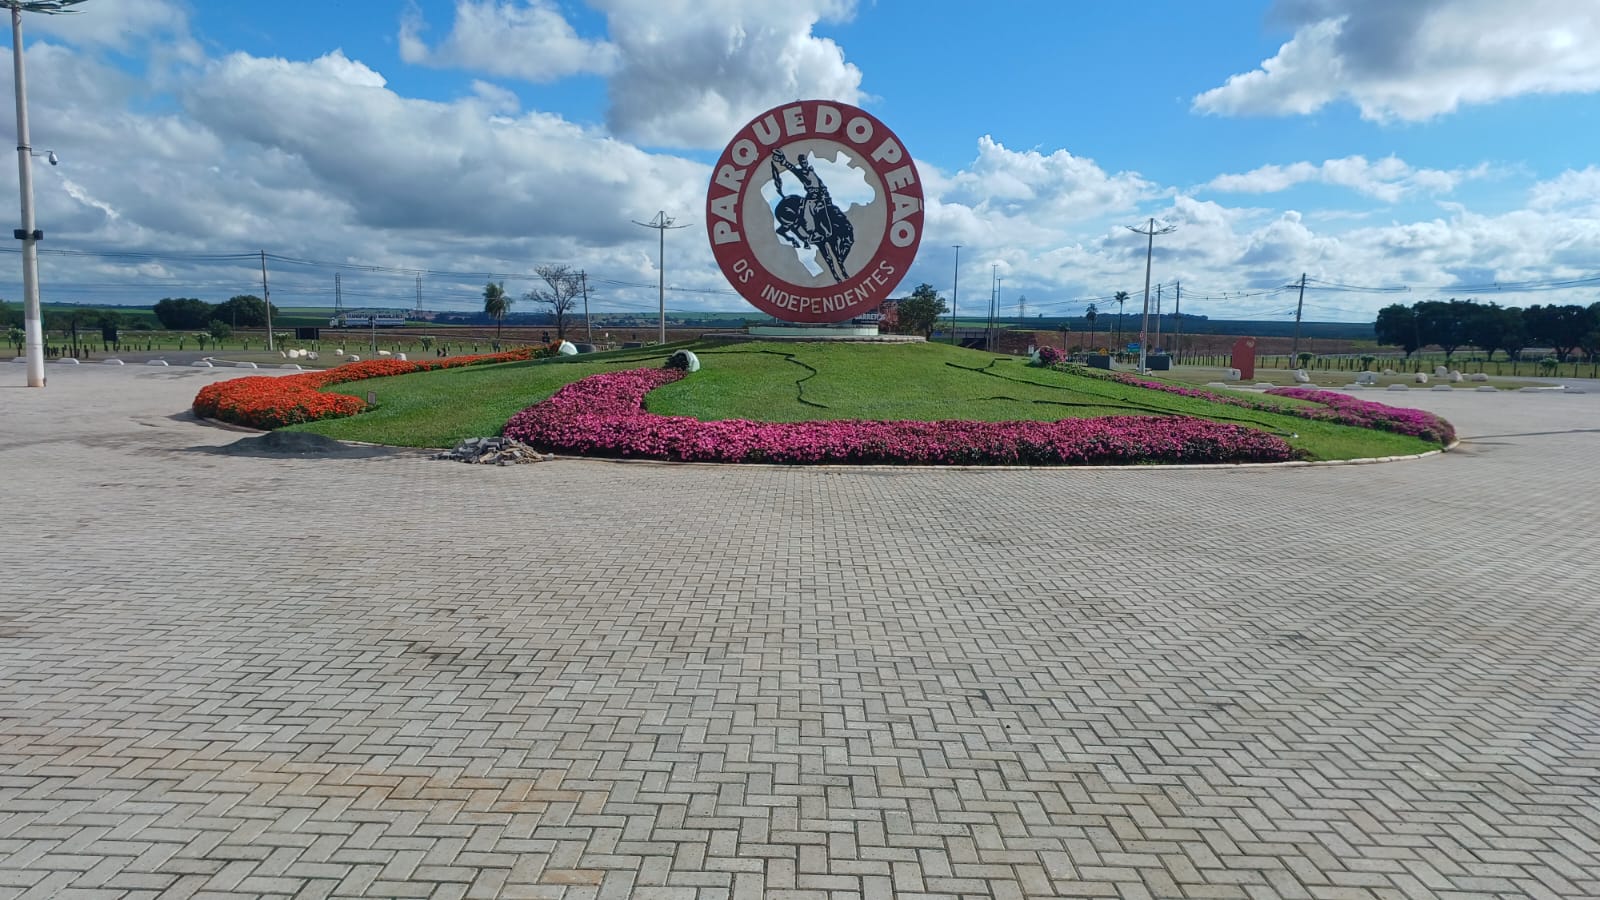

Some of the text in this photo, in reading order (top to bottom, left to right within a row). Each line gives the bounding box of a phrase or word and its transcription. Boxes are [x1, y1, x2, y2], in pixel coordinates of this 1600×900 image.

[711, 105, 923, 248] PARQUE DO PEÃO
[733, 259, 894, 313] OS INDEPENDENTES
